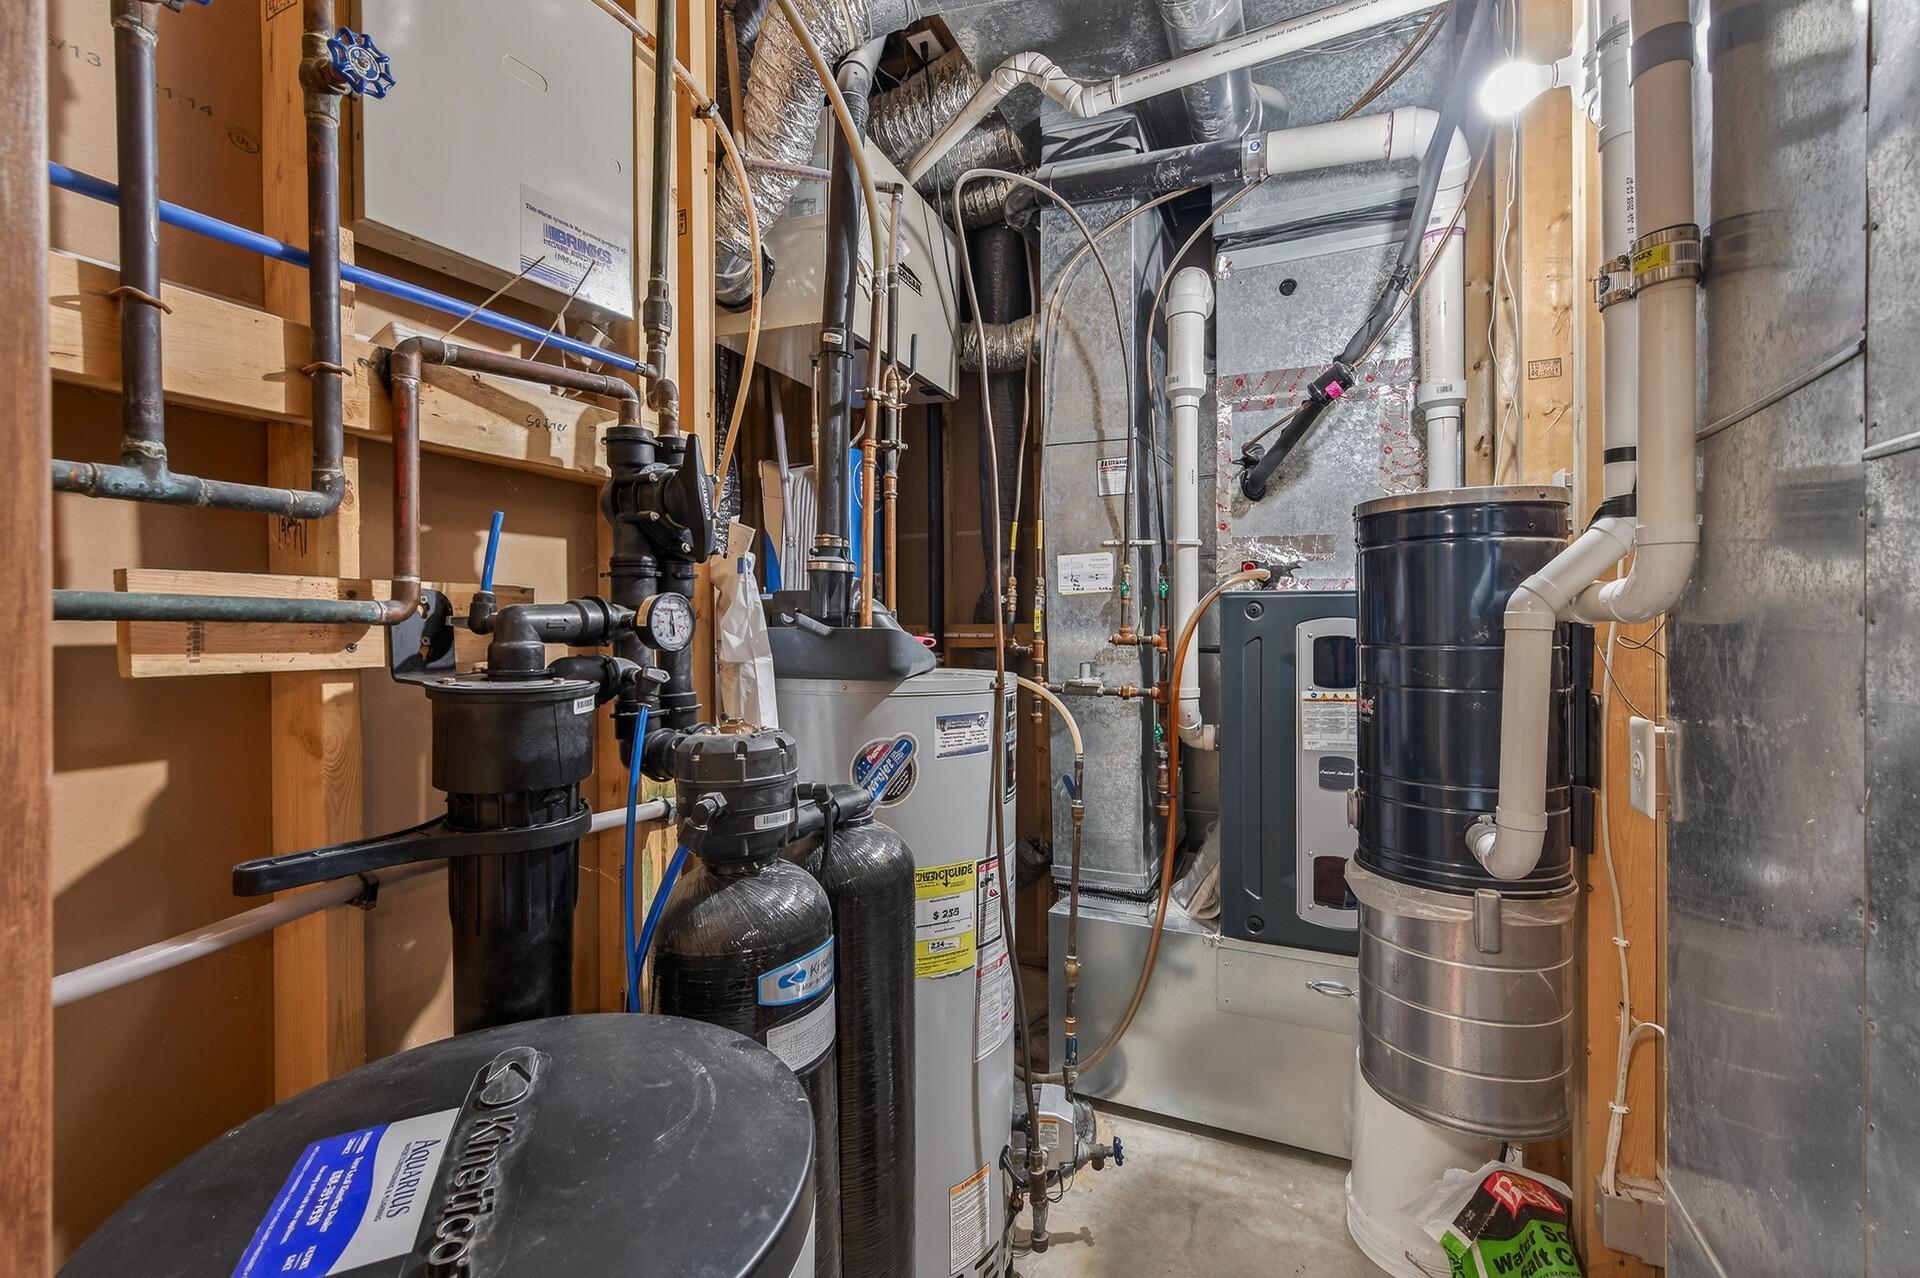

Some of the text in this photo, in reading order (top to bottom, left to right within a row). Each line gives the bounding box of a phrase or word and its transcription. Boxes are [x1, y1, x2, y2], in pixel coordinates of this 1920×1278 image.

[386, 1138, 442, 1219] AQUARIUS
[428, 1112, 520, 1266] Kinetico
[1493, 1230, 1536, 1275] Water
